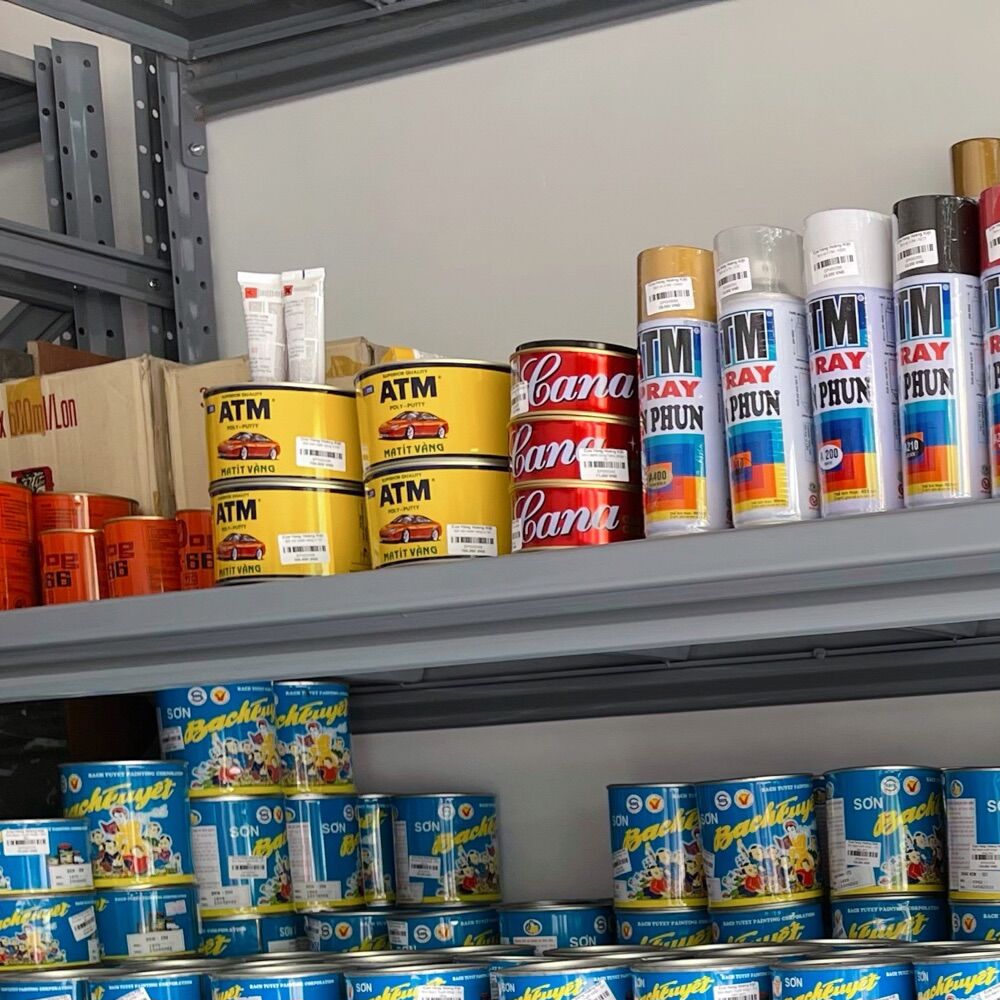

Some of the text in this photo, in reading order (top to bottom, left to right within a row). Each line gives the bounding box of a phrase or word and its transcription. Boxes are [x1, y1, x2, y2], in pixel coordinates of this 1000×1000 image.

[380, 375, 437, 403] ATM
[521, 353, 635, 407] Cana
[820, 377, 870, 408] PHUN
[219, 398, 271, 423] ATM
[651, 404, 704, 431] PHUN
[414, 442, 444, 453] VÀNG
[247, 462, 275, 474] VÀNG
[380, 478, 431, 507] ATM
[216, 499, 257, 525] ATM
[514, 490, 620, 543] Cana
[411, 545, 438, 556] VÀNG
[237, 563, 262, 574] VÀNG
[167, 706, 191, 720] SƠN
[853, 796, 883, 811] SƠN
[229, 825, 259, 838] SƠN
[414, 821, 440, 834] SƠN
